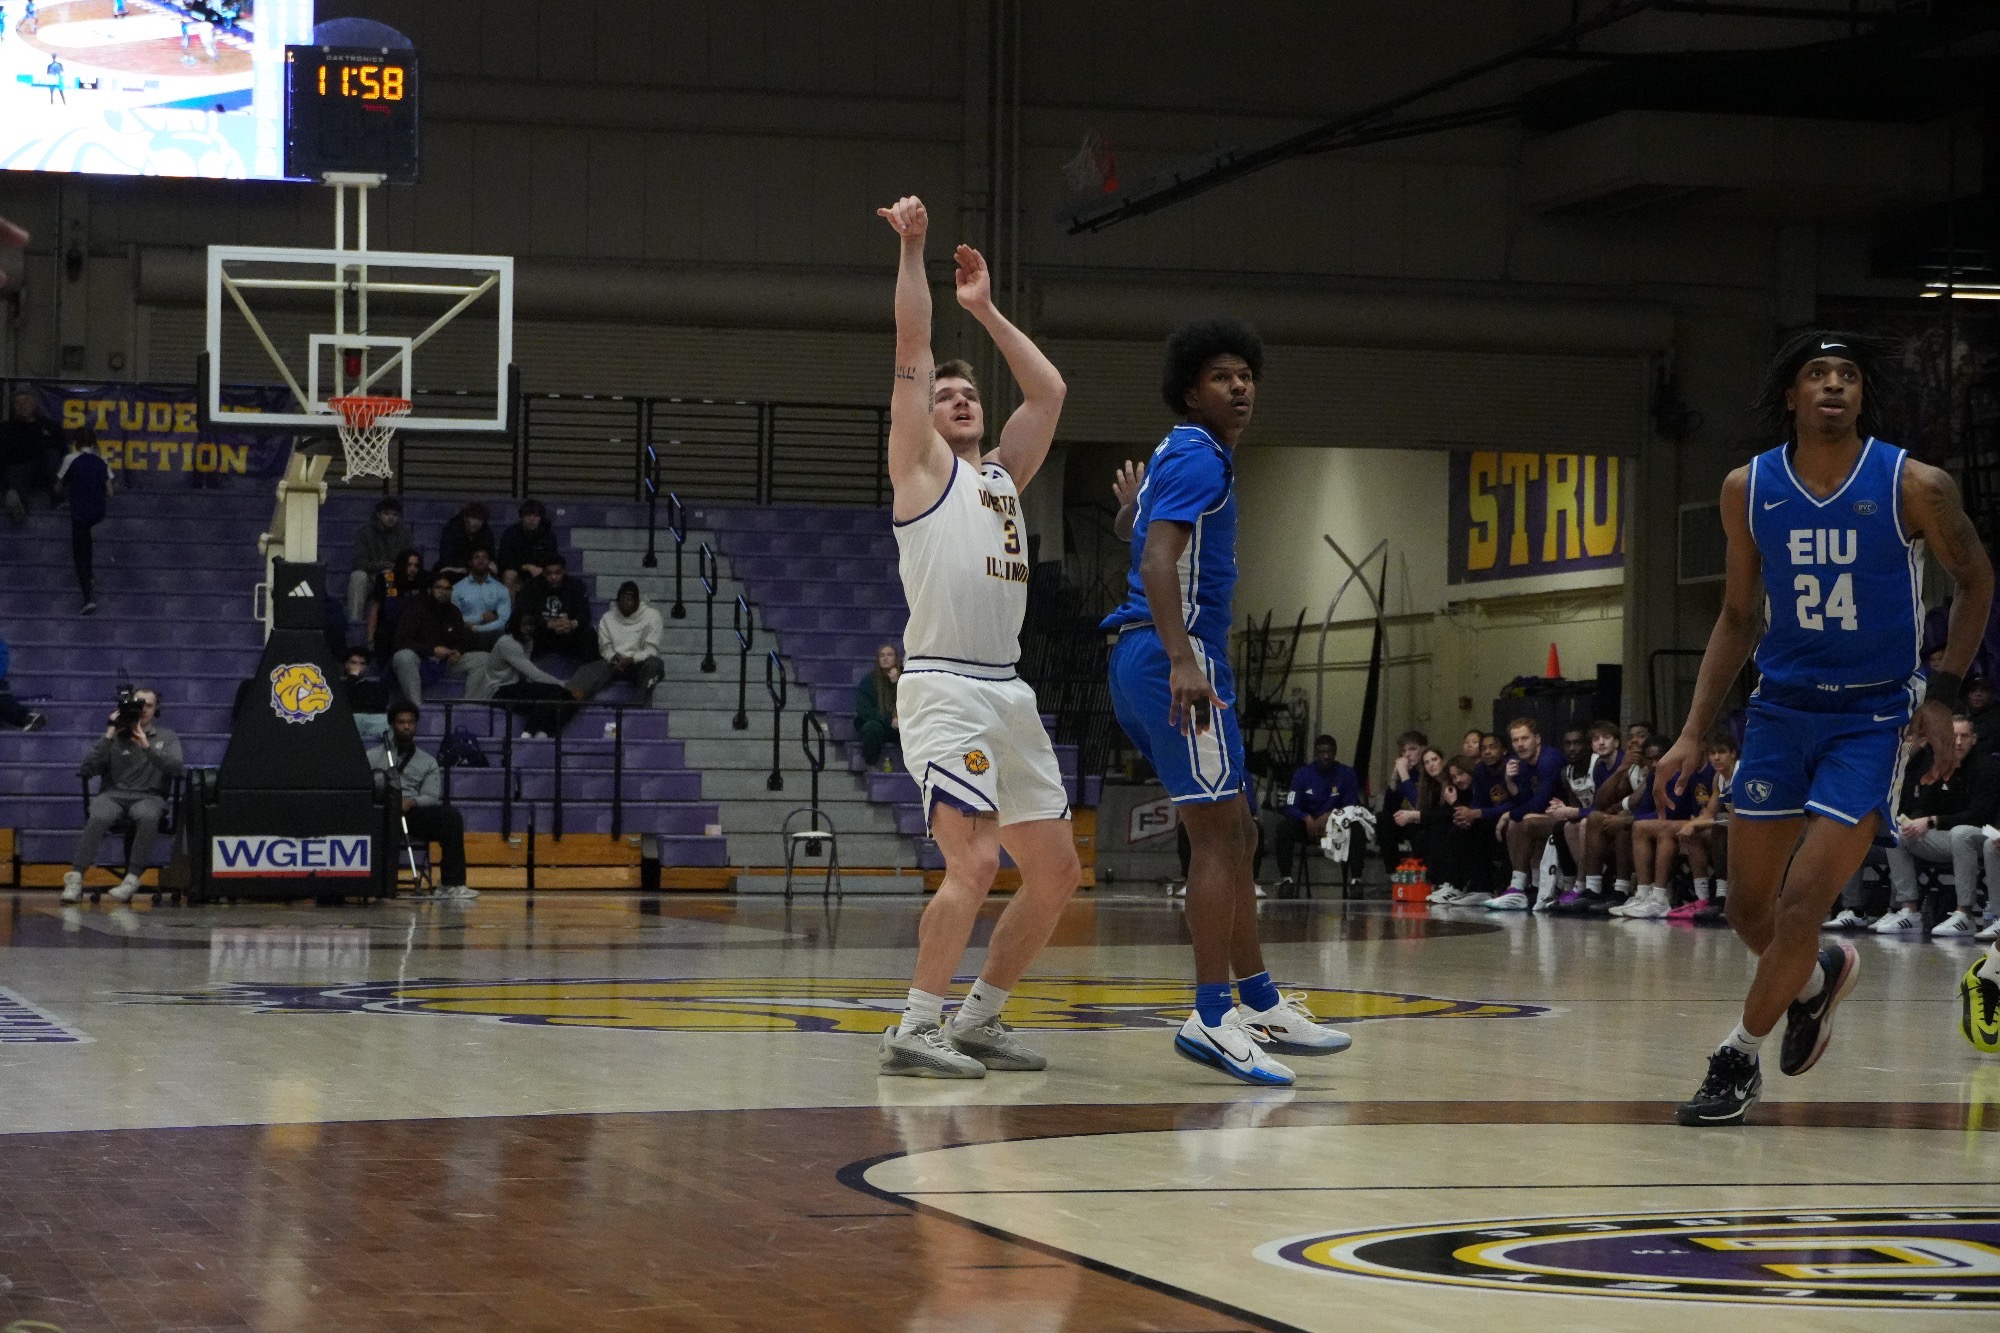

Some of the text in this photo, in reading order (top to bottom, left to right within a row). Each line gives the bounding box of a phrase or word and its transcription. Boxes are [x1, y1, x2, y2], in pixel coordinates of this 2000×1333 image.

[326, 55, 384, 63] DAKTRONICS
[318, 65, 404, 100] 11:58
[62, 399, 262, 433] STUDE
[71, 440, 249, 475] ECTION
[1467, 450, 1626, 571] STRU
[1004, 519, 1021, 555] 3
[1786, 528, 1857, 565] EIU
[1794, 572, 1858, 631] 24
[1140, 806, 1169, 831] FS
[217, 839, 368, 867] WGEM
